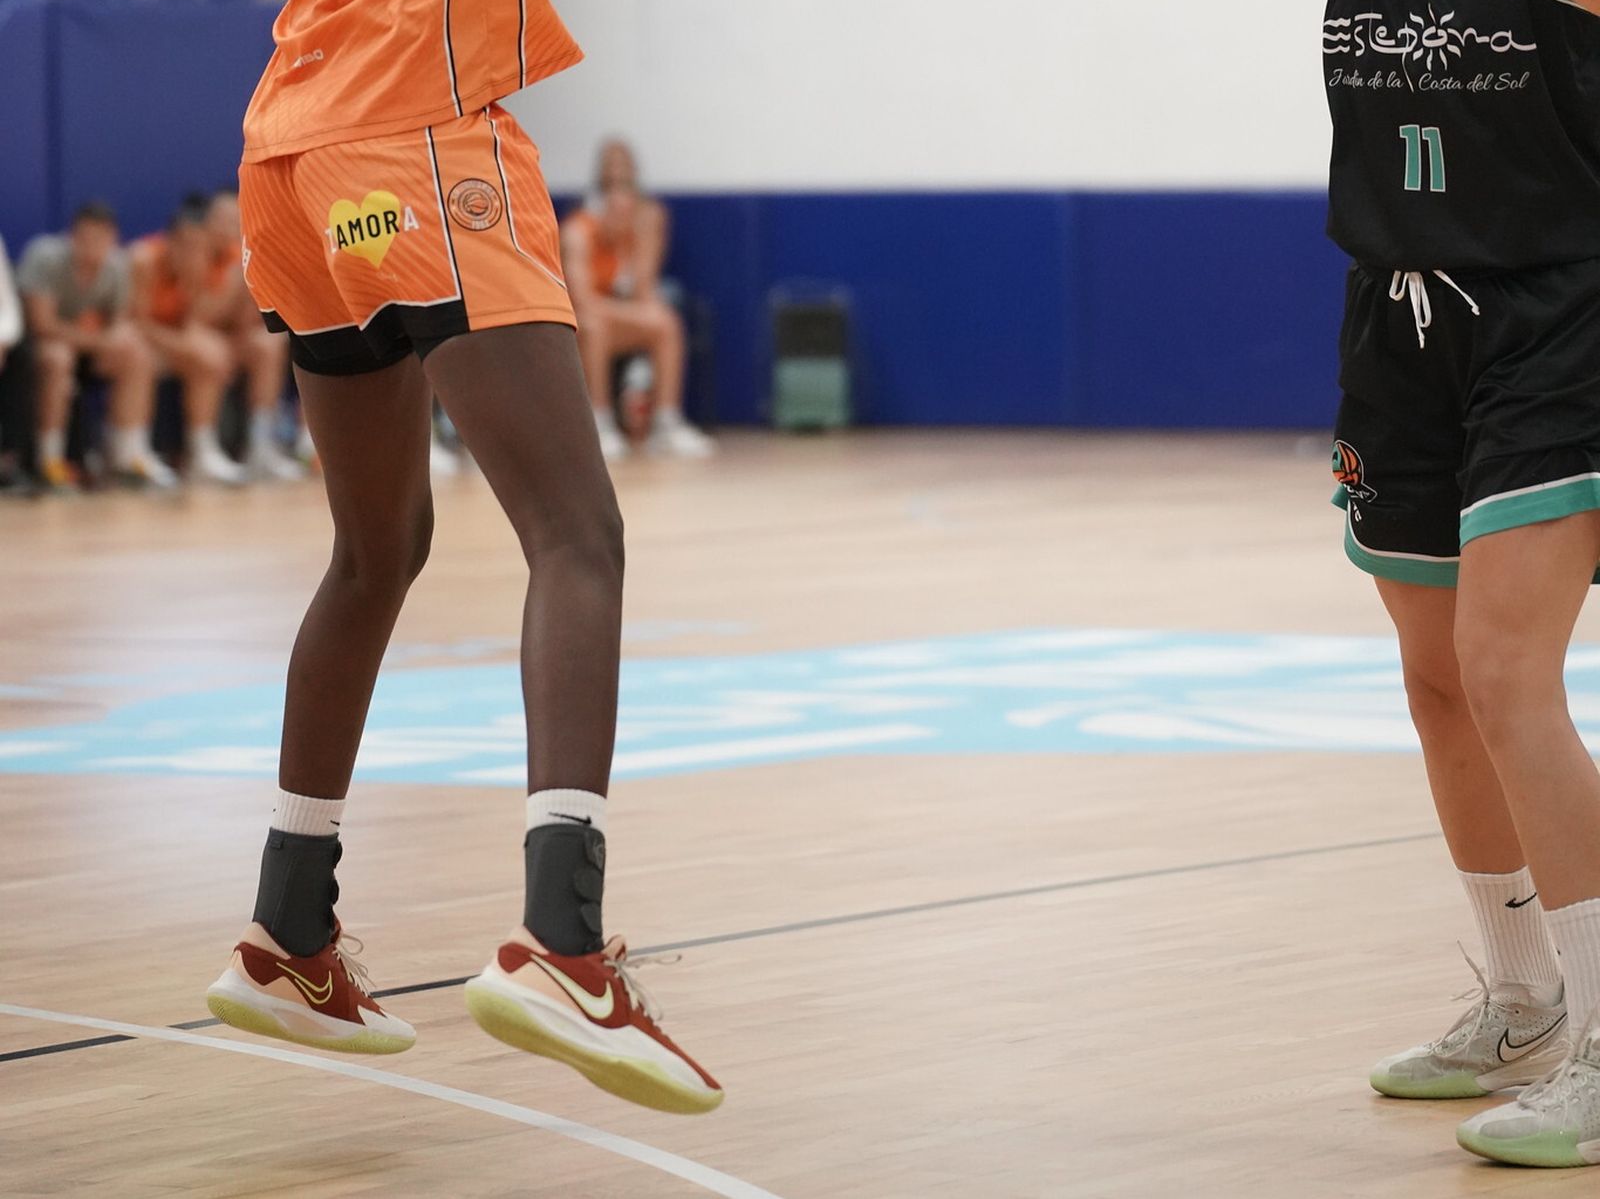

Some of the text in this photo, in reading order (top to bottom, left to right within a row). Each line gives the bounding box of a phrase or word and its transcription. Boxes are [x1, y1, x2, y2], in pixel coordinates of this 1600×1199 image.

[1367, 70, 1385, 90] de
[1386, 70, 1405, 89] la
[1418, 72, 1464, 91] Costa
[1466, 72, 1491, 93] del
[1494, 71, 1530, 91] Sol
[1399, 124, 1446, 192] 11
